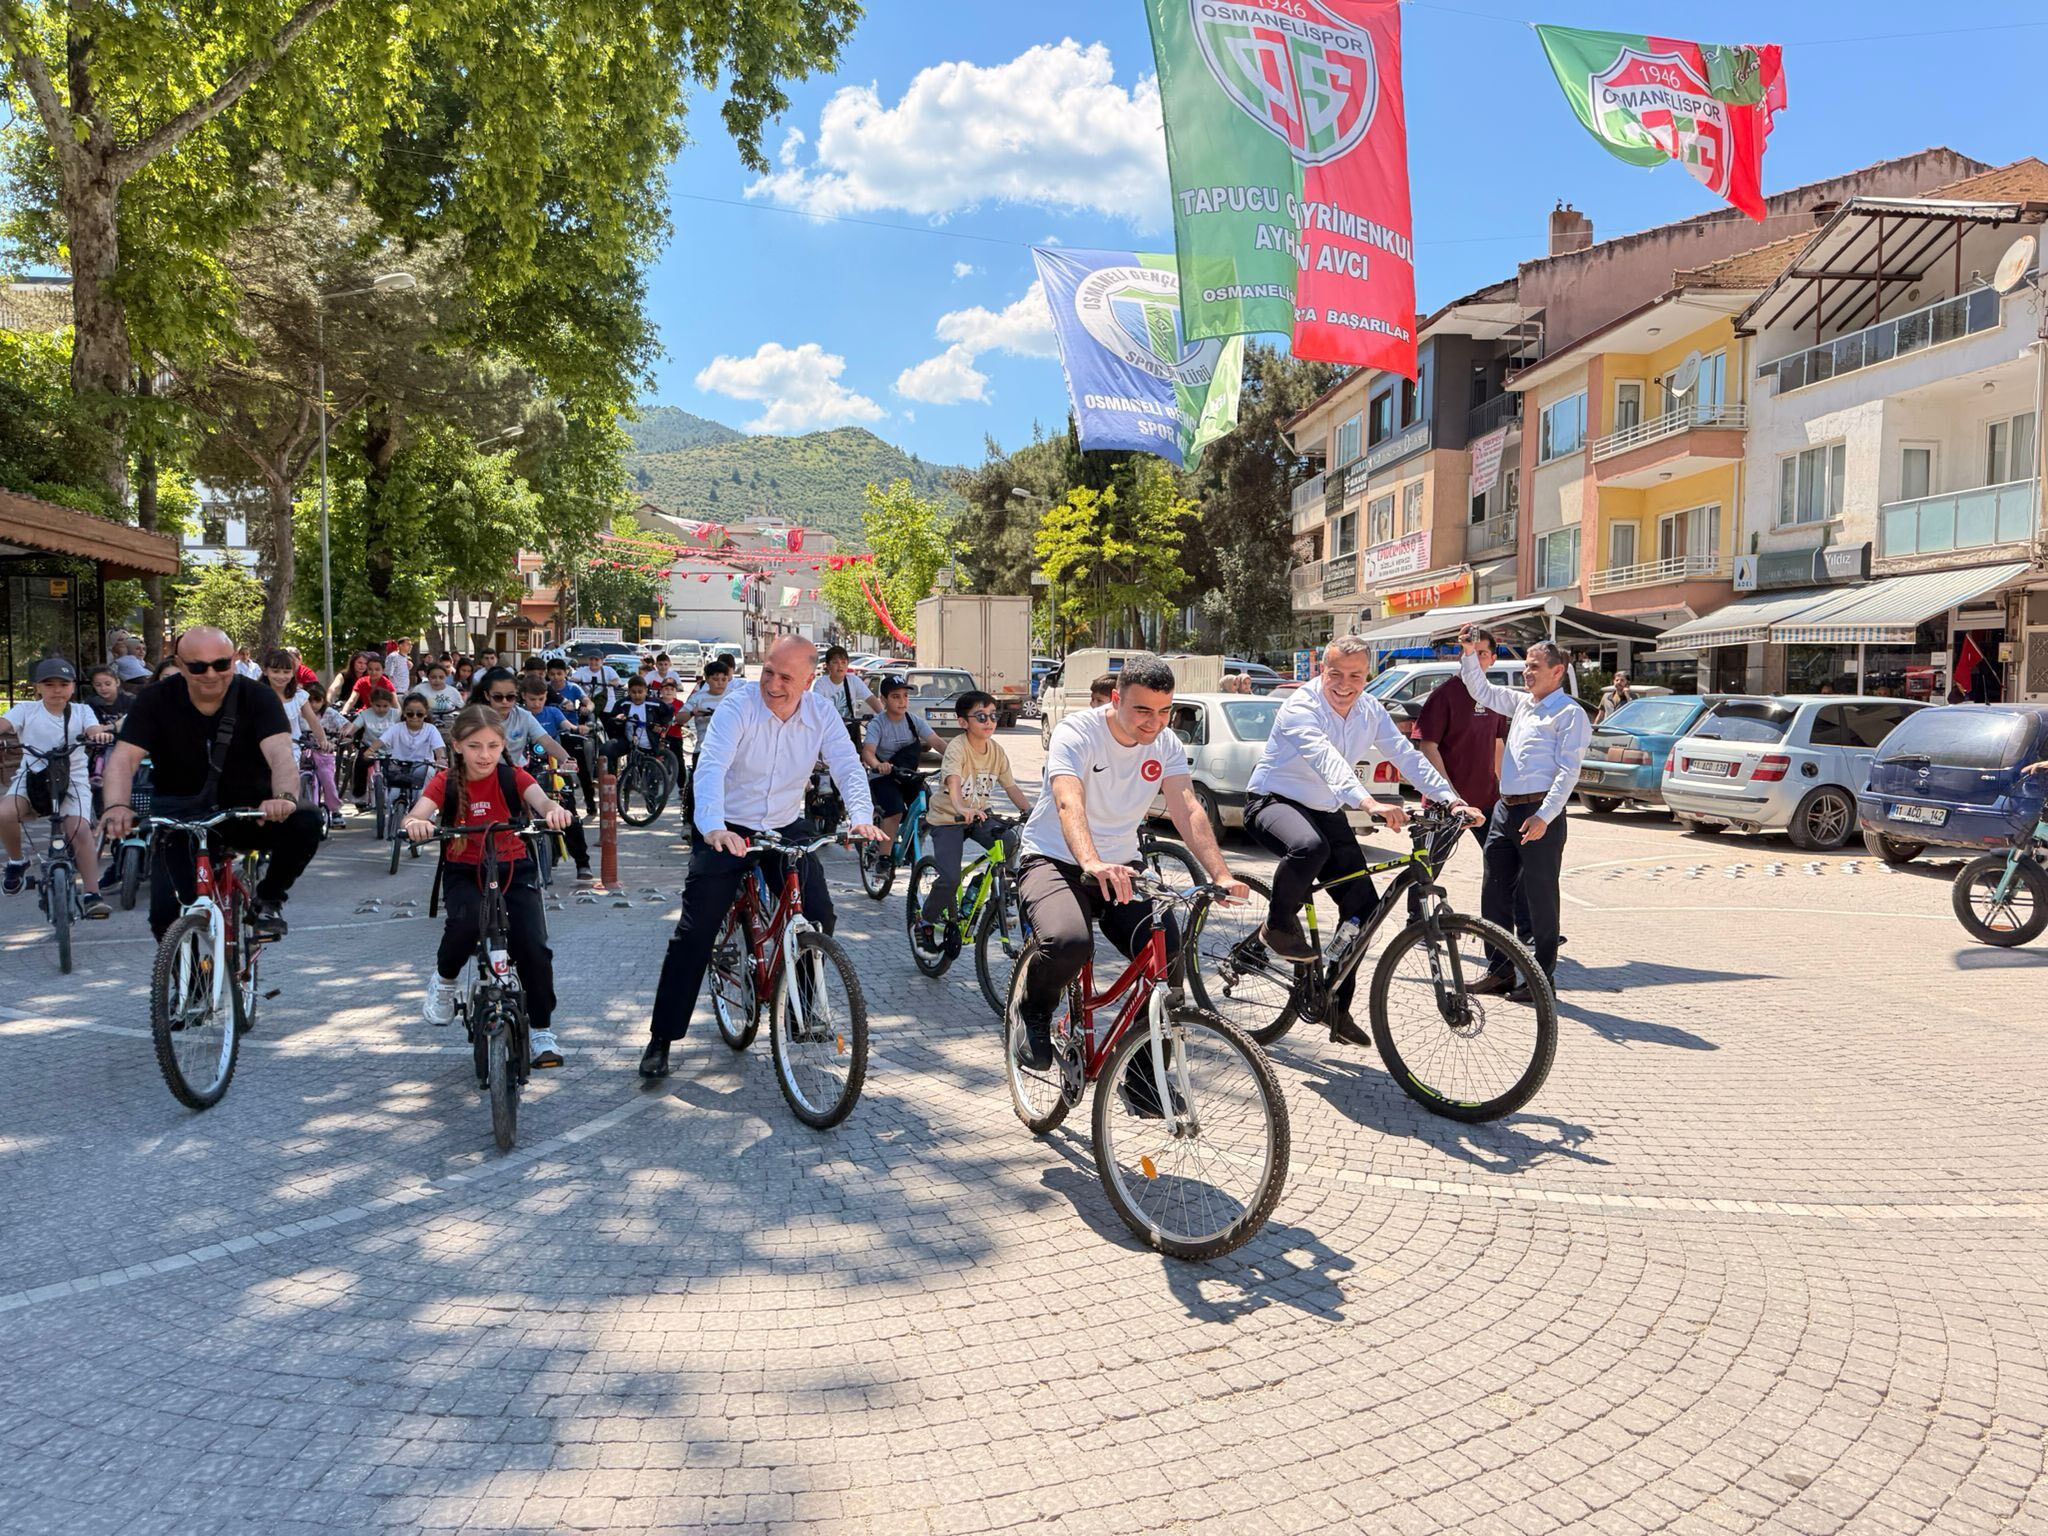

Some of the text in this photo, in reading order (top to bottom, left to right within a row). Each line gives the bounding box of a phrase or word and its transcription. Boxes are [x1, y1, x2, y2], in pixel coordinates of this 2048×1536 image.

[1201, 4, 1365, 54] OSMANELİSPOR
[1639, 65, 1681, 89] 1946
[1178, 186, 1280, 216] TAPUCU
[1255, 223, 1368, 281] AYHN AVCI
[1129, 269, 1178, 290] GENÇL
[1202, 285, 1411, 343] OSMANELİR'A BAŞARILAR
[1825, 553, 1851, 566] Yıldız
[1895, 806, 1903, 815] 11
